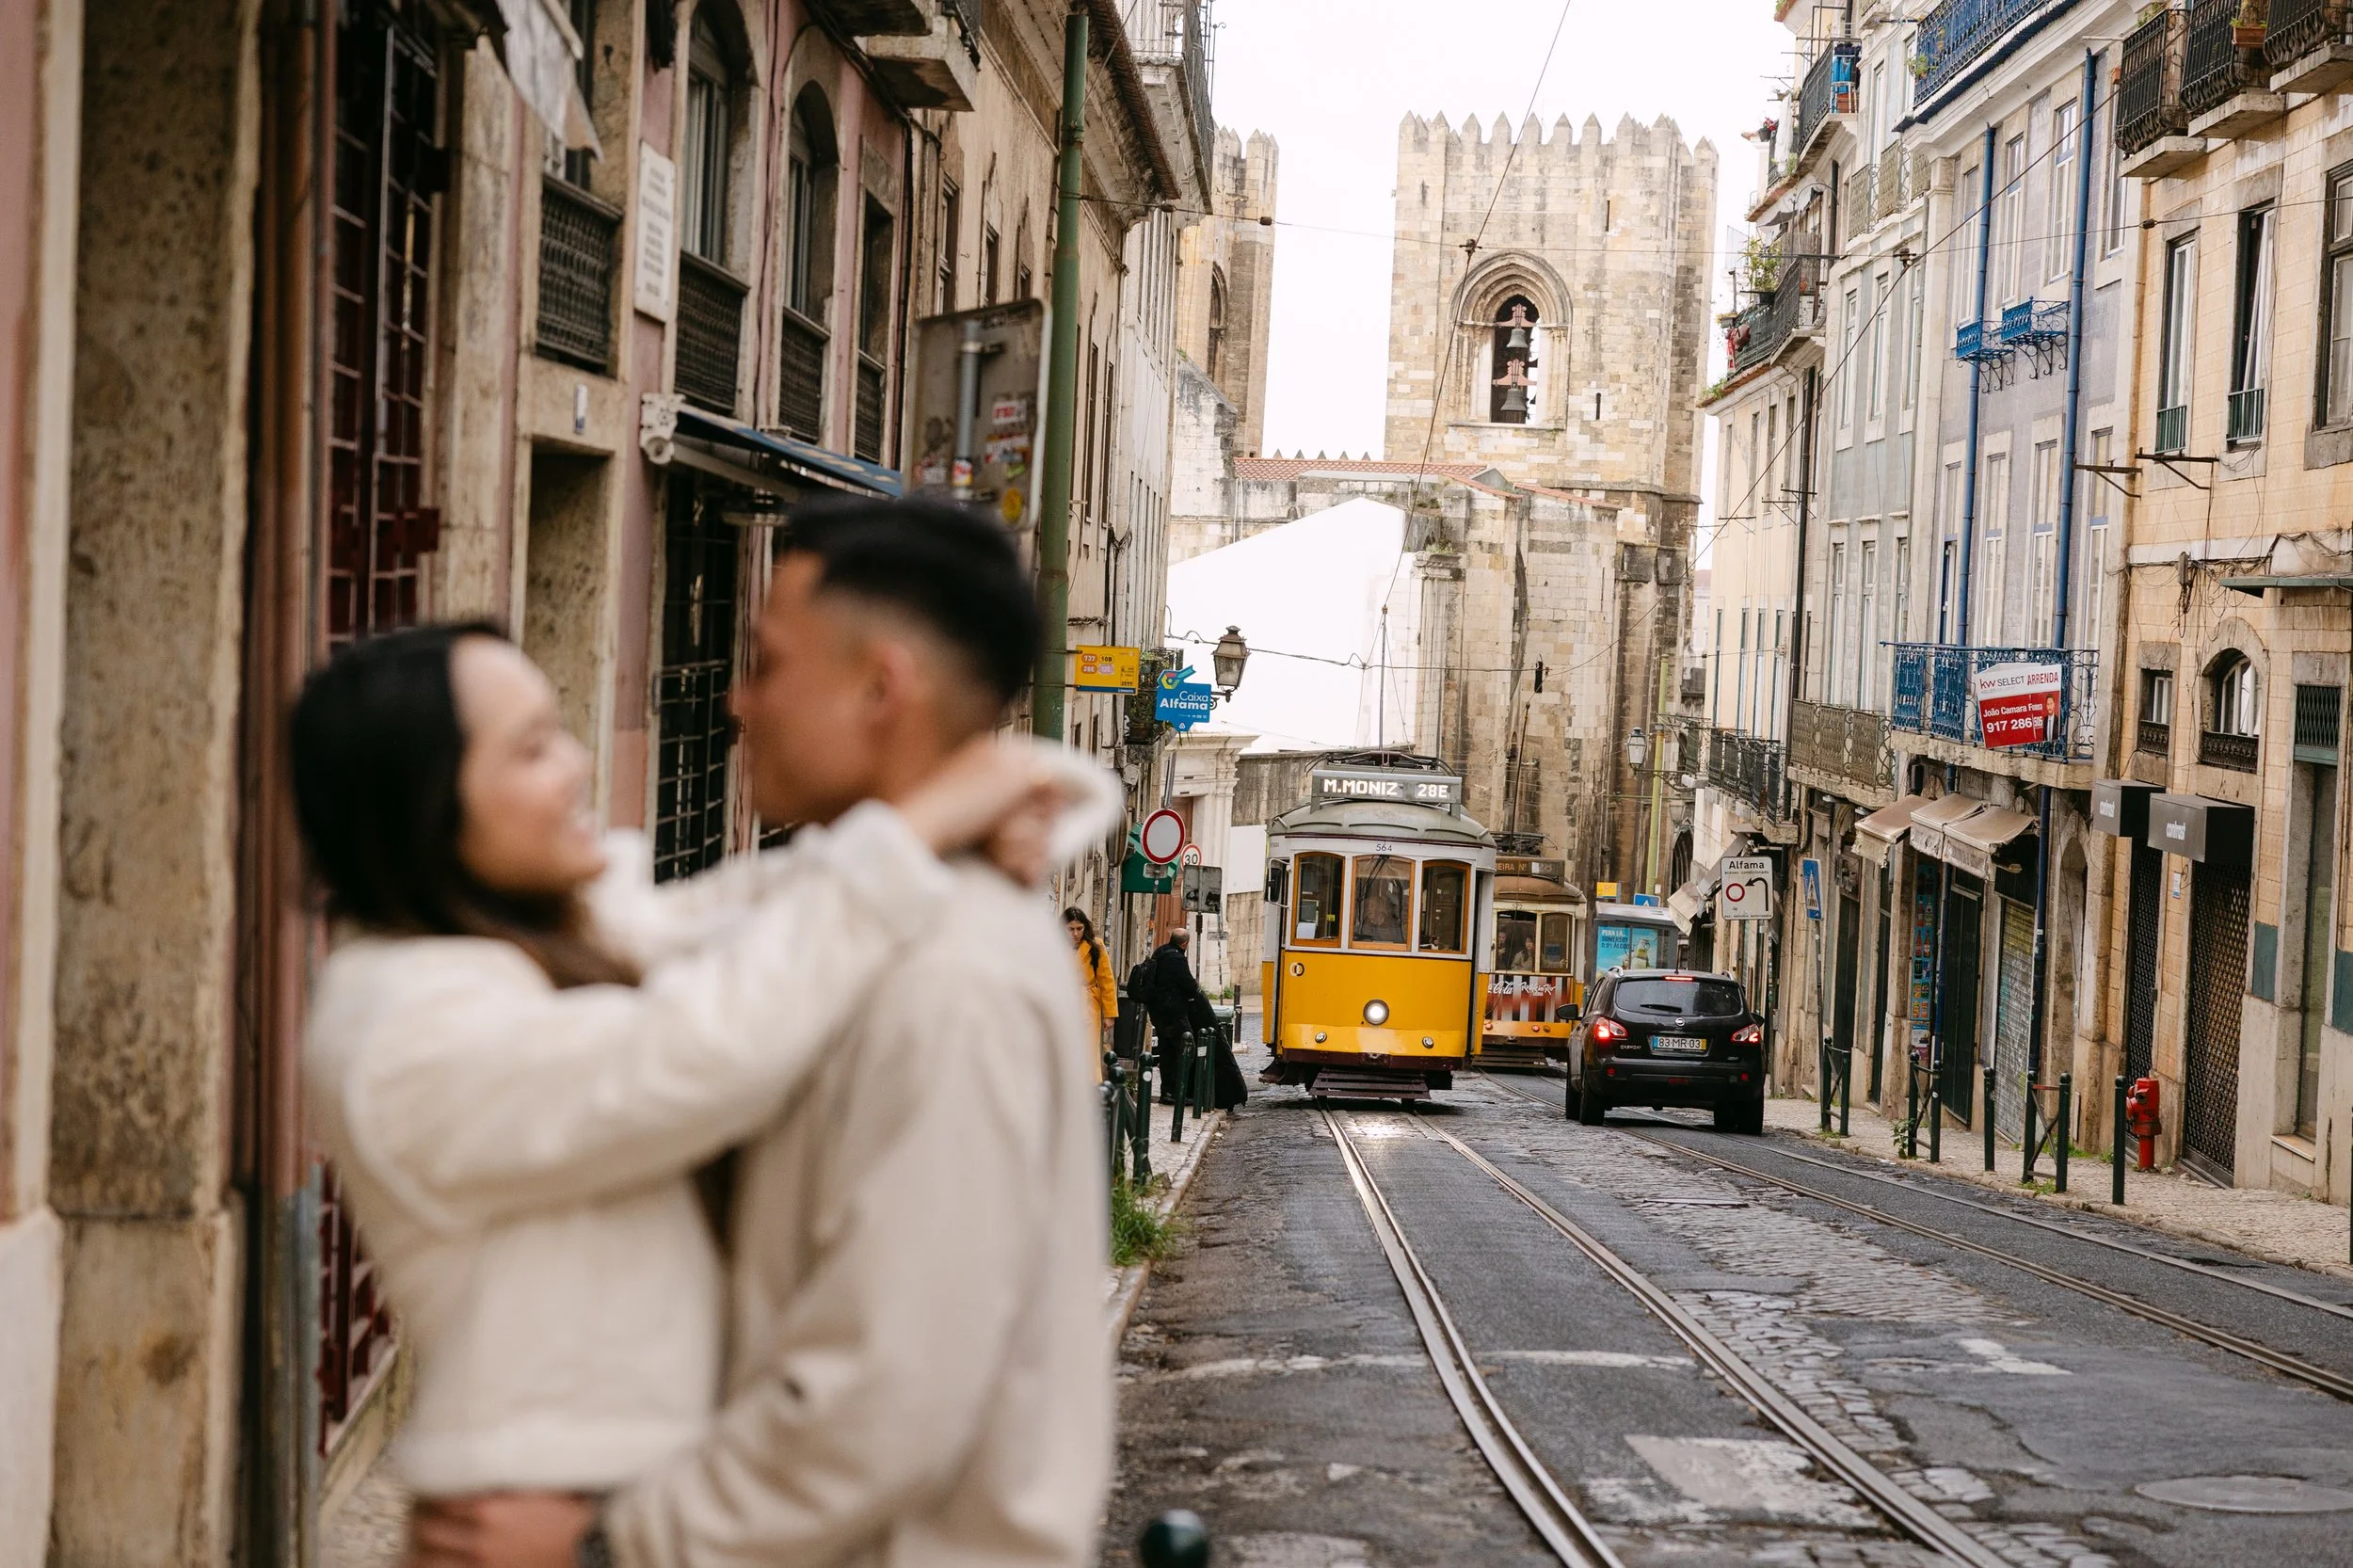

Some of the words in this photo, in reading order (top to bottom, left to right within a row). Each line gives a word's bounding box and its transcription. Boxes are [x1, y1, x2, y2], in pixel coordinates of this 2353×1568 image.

[1979, 679, 1996, 690] kw
[1997, 676, 2025, 687] SELECT
[2026, 671, 2058, 686] ARRENDA
[1178, 690, 1209, 702] Caixa
[1159, 697, 1208, 711] Alfama
[1983, 707, 2000, 718] João
[1986, 720, 2008, 733] 917
[2010, 717, 2033, 730] 286
[1323, 778, 1398, 796] M.MONIZ
[1417, 783, 1449, 798] 28E
[1375, 843, 1393, 853] 564
[1184, 854, 1198, 865] 30
[1728, 860, 1765, 870] Alfama
